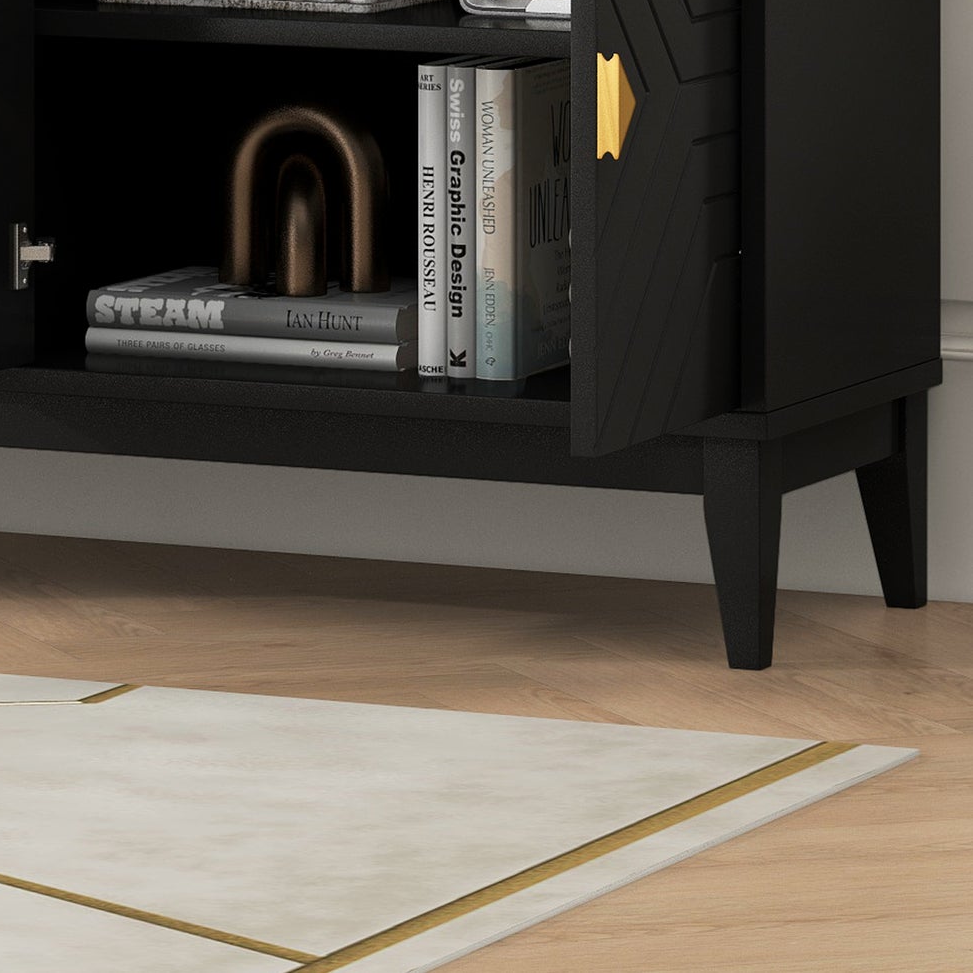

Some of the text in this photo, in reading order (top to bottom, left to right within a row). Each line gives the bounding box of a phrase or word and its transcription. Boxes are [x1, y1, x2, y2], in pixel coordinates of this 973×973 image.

[420, 74, 434, 82] ART
[480, 100, 497, 235] WOMAN UNLEASHED
[448, 78, 467, 318] Swiss Graphic Design
[422, 166, 437, 312] HENRI ROUSSEAU
[483, 267, 496, 292] JENN
[95, 294, 225, 330] STEAM
[286, 309, 363, 331] IAN HUNT
[117, 339, 226, 353] THREE PAIRS OF GLASSES
[311, 347, 320, 358] by
[323, 349, 343, 360] Greg
